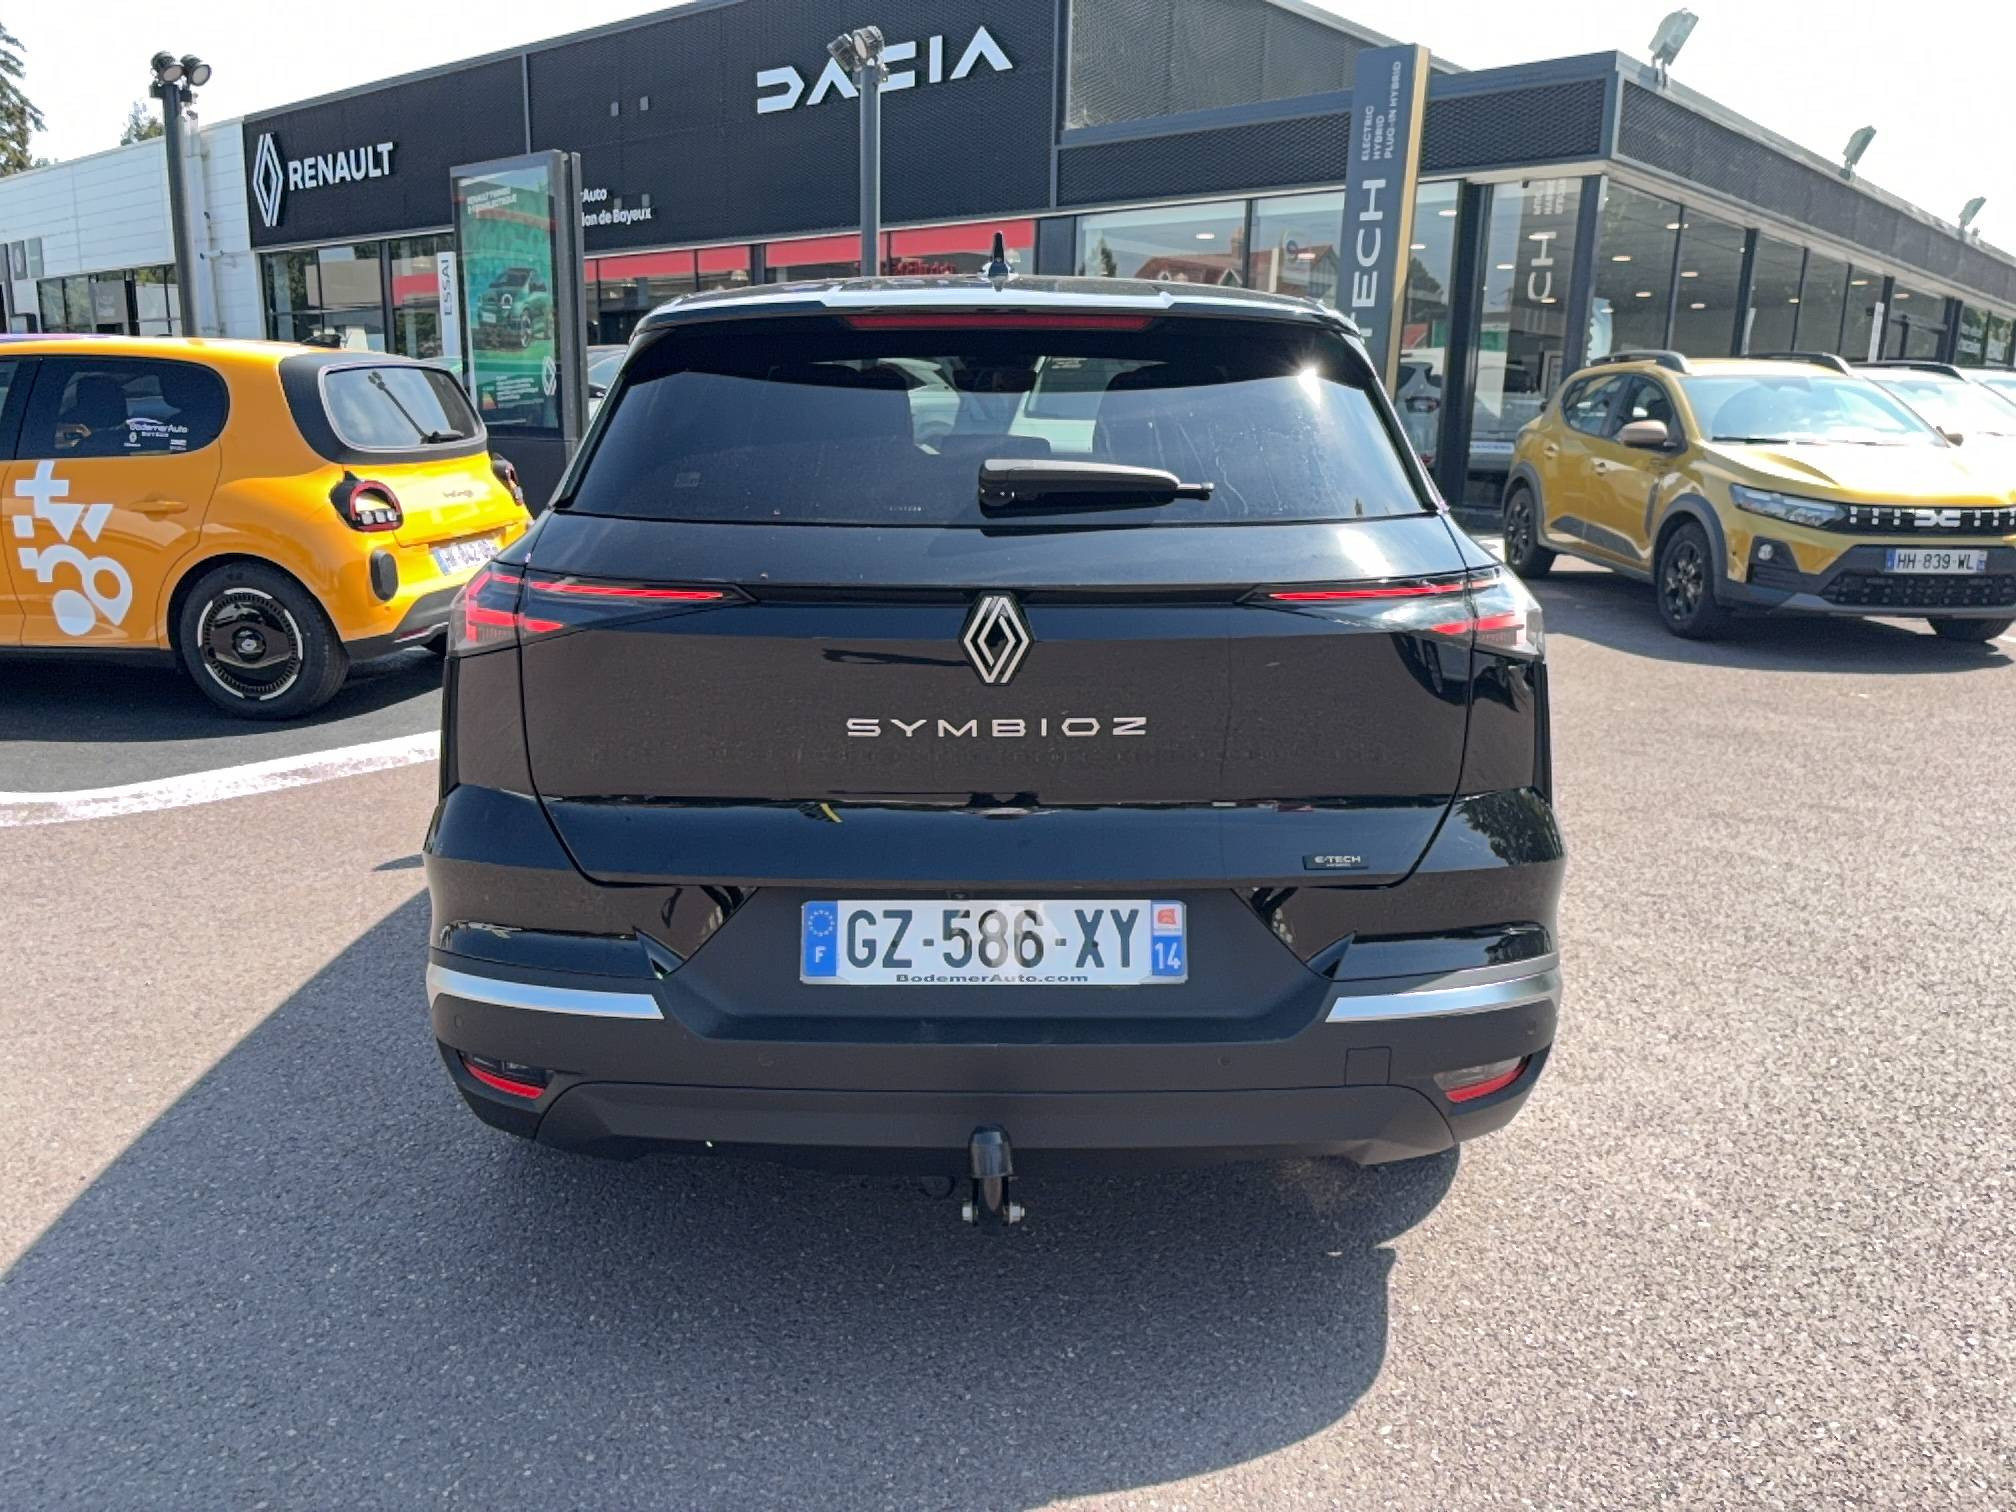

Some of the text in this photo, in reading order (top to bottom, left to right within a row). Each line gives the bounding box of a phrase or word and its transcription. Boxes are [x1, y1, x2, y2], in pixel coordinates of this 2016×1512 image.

[757, 25, 1013, 114] DACIA
[1361, 105, 1375, 161] ELECTRIC
[1383, 61, 1402, 159] PLUG-IN HYBRID
[1372, 114, 1385, 160] HYBRID
[287, 141, 394, 191] RENAULT
[599, 209, 612, 225] de
[612, 207, 652, 225] Bayeux
[441, 259, 453, 316] ESSAI
[846, 717, 1147, 738] SYMBIOZ
[815, 945, 827, 963] F
[846, 909, 1140, 969] GZ-586-XY
[1155, 942, 1182, 970] 14
[896, 973, 1089, 983] BodemerAuto.com
